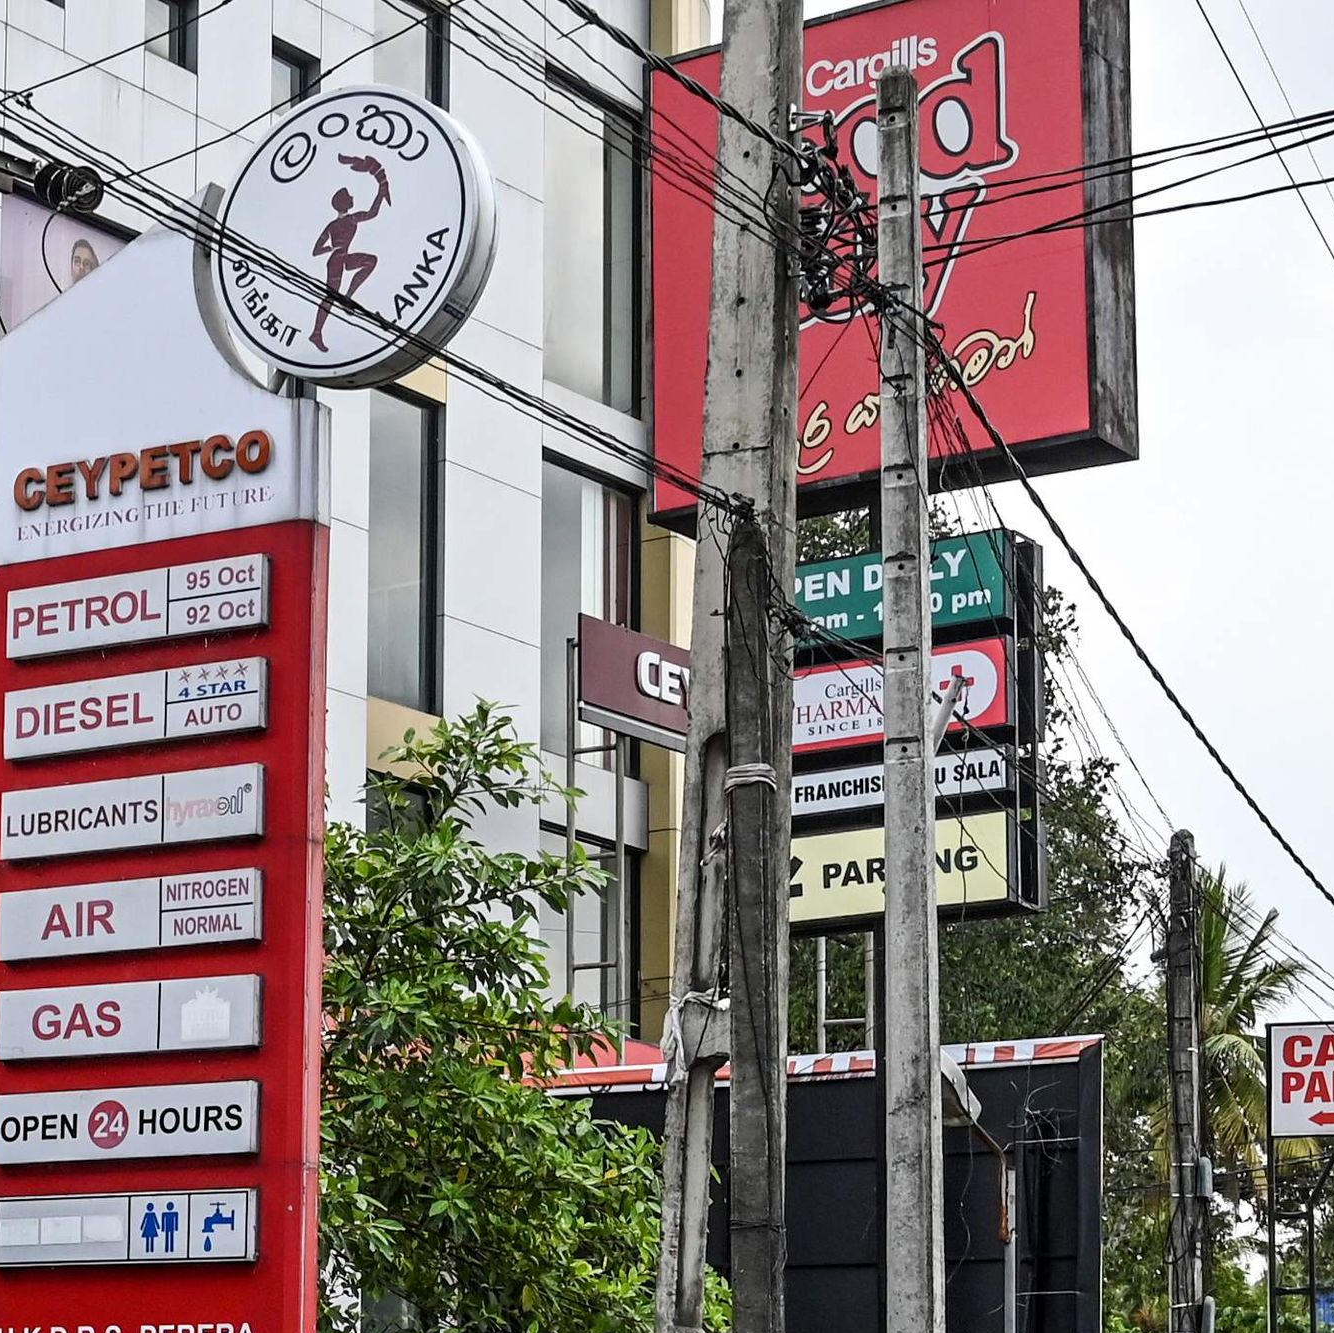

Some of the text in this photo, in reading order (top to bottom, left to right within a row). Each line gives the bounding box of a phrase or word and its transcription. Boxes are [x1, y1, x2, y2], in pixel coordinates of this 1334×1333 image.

[806, 35, 938, 97] Cargills
[271, 106, 429, 183] ලංකා
[14, 430, 273, 511] CEYPETCO
[17, 486, 272, 541] ENERGIZING THE FUTURE
[12, 563, 255, 640] PETROL 95 Oct
[186, 598, 256, 626] 92 Oct
[951, 588, 992, 614] pm
[177, 678, 248, 699] 4 STAR
[824, 677, 882, 699] Cargills
[15, 691, 243, 740] DIESEL AUTO
[807, 721, 860, 736] SINCE
[794, 775, 885, 804] FRANCHIS
[953, 759, 1000, 782] SALA
[6, 799, 159, 838] LUBRICANTS
[822, 845, 979, 889] PARNG
[40, 876, 250, 941] AIR NITROGEN
[172, 912, 243, 938] NORMAL
[31, 1000, 123, 1041] GAS
[0, 1103, 244, 1143] OPEN 24 HOURS
